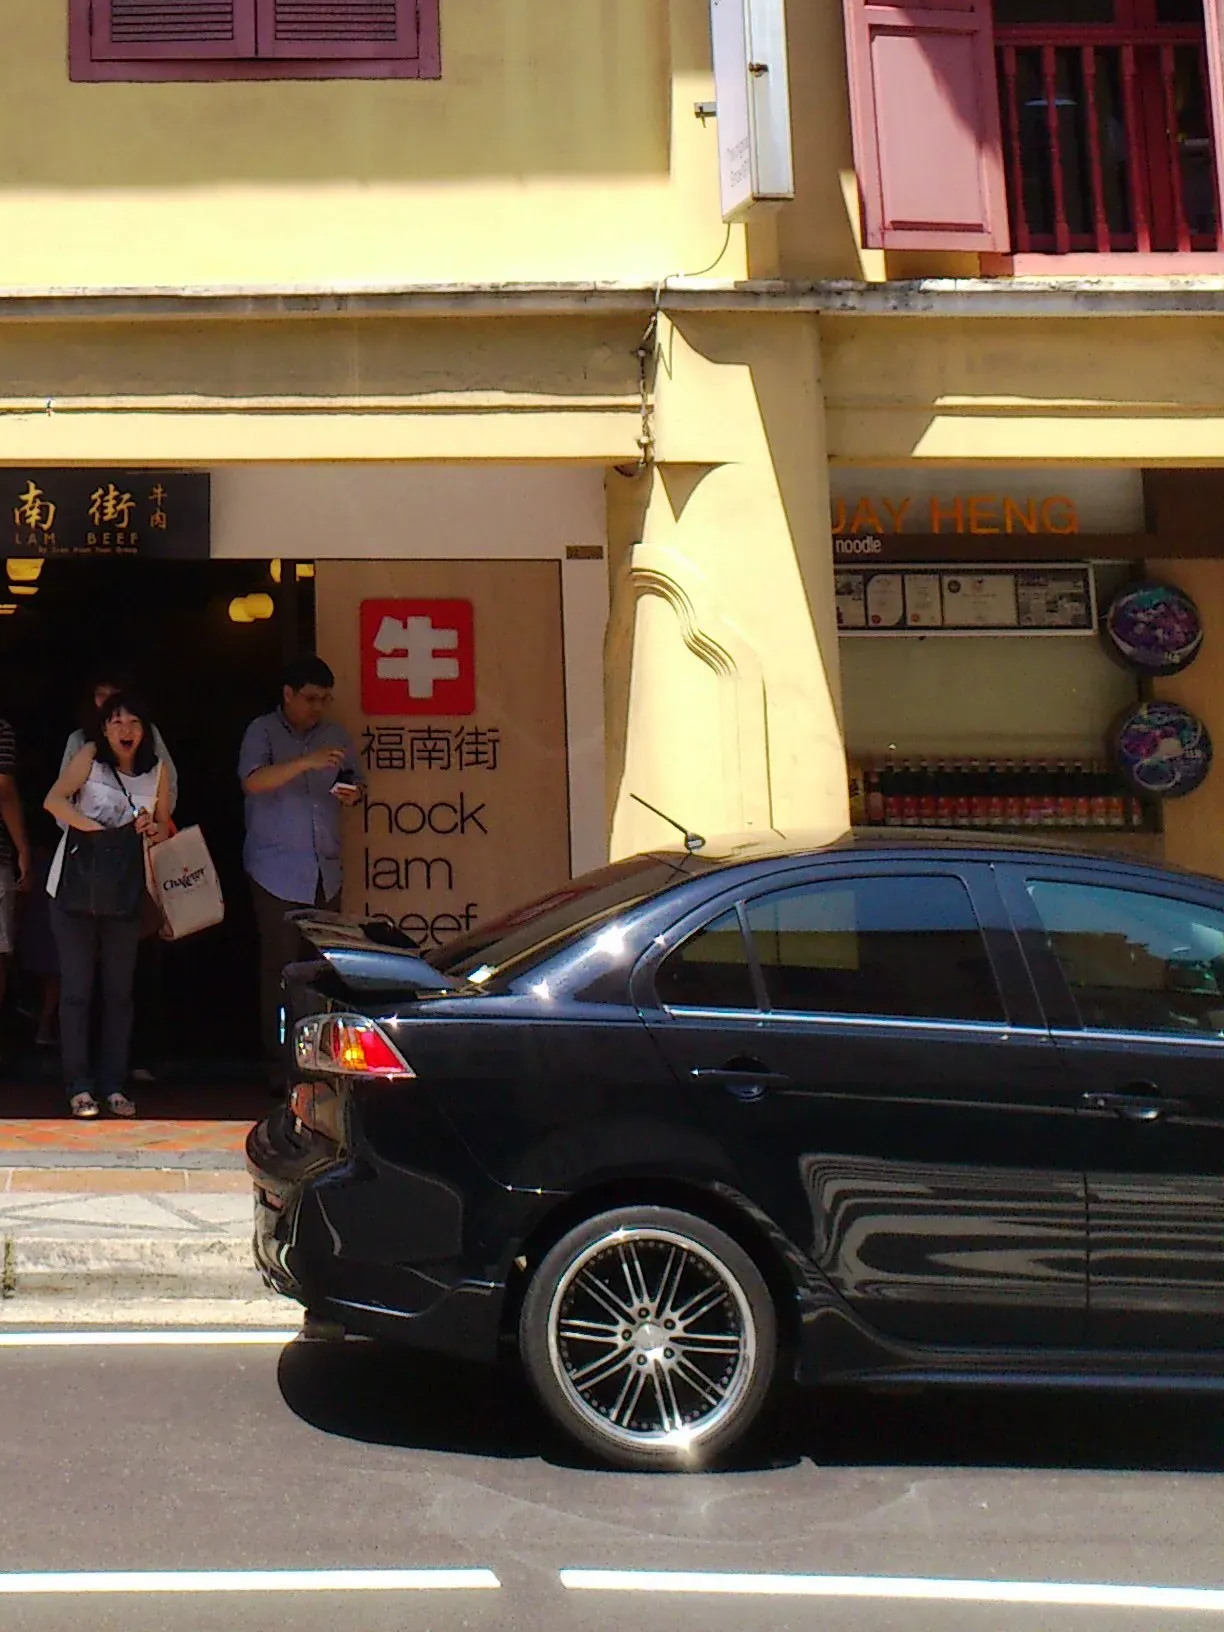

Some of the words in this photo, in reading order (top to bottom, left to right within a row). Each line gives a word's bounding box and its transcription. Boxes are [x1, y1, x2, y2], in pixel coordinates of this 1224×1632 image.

[148, 483, 168, 530] 牛肉
[929, 494, 1080, 535] HENG
[15, 532, 57, 546] LAM
[87, 532, 140, 545] BEEF
[835, 535, 882, 553] noodle
[361, 725, 500, 770] 福南街
[364, 792, 488, 834] hock
[364, 847, 453, 891] lam
